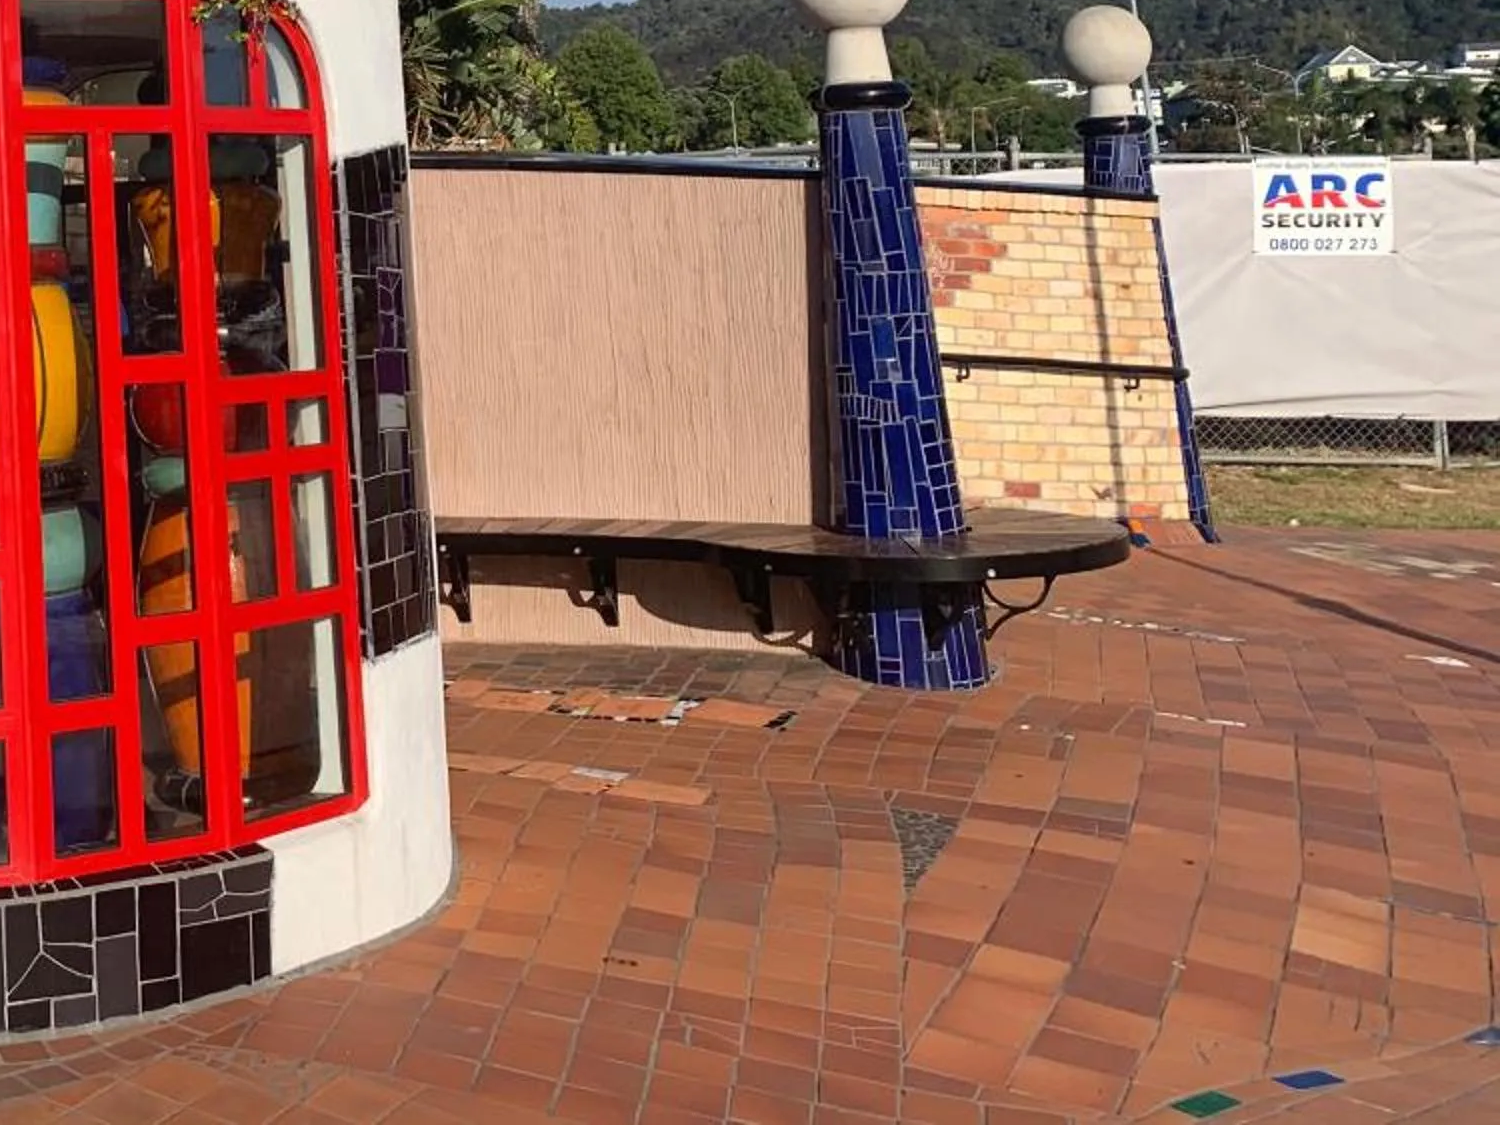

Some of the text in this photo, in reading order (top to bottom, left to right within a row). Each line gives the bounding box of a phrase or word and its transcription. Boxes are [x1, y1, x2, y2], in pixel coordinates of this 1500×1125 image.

[1263, 173, 1386, 208] ARC
[1262, 213, 1384, 228] SECURITY
[1269, 238, 1378, 251] 0800 027 273
